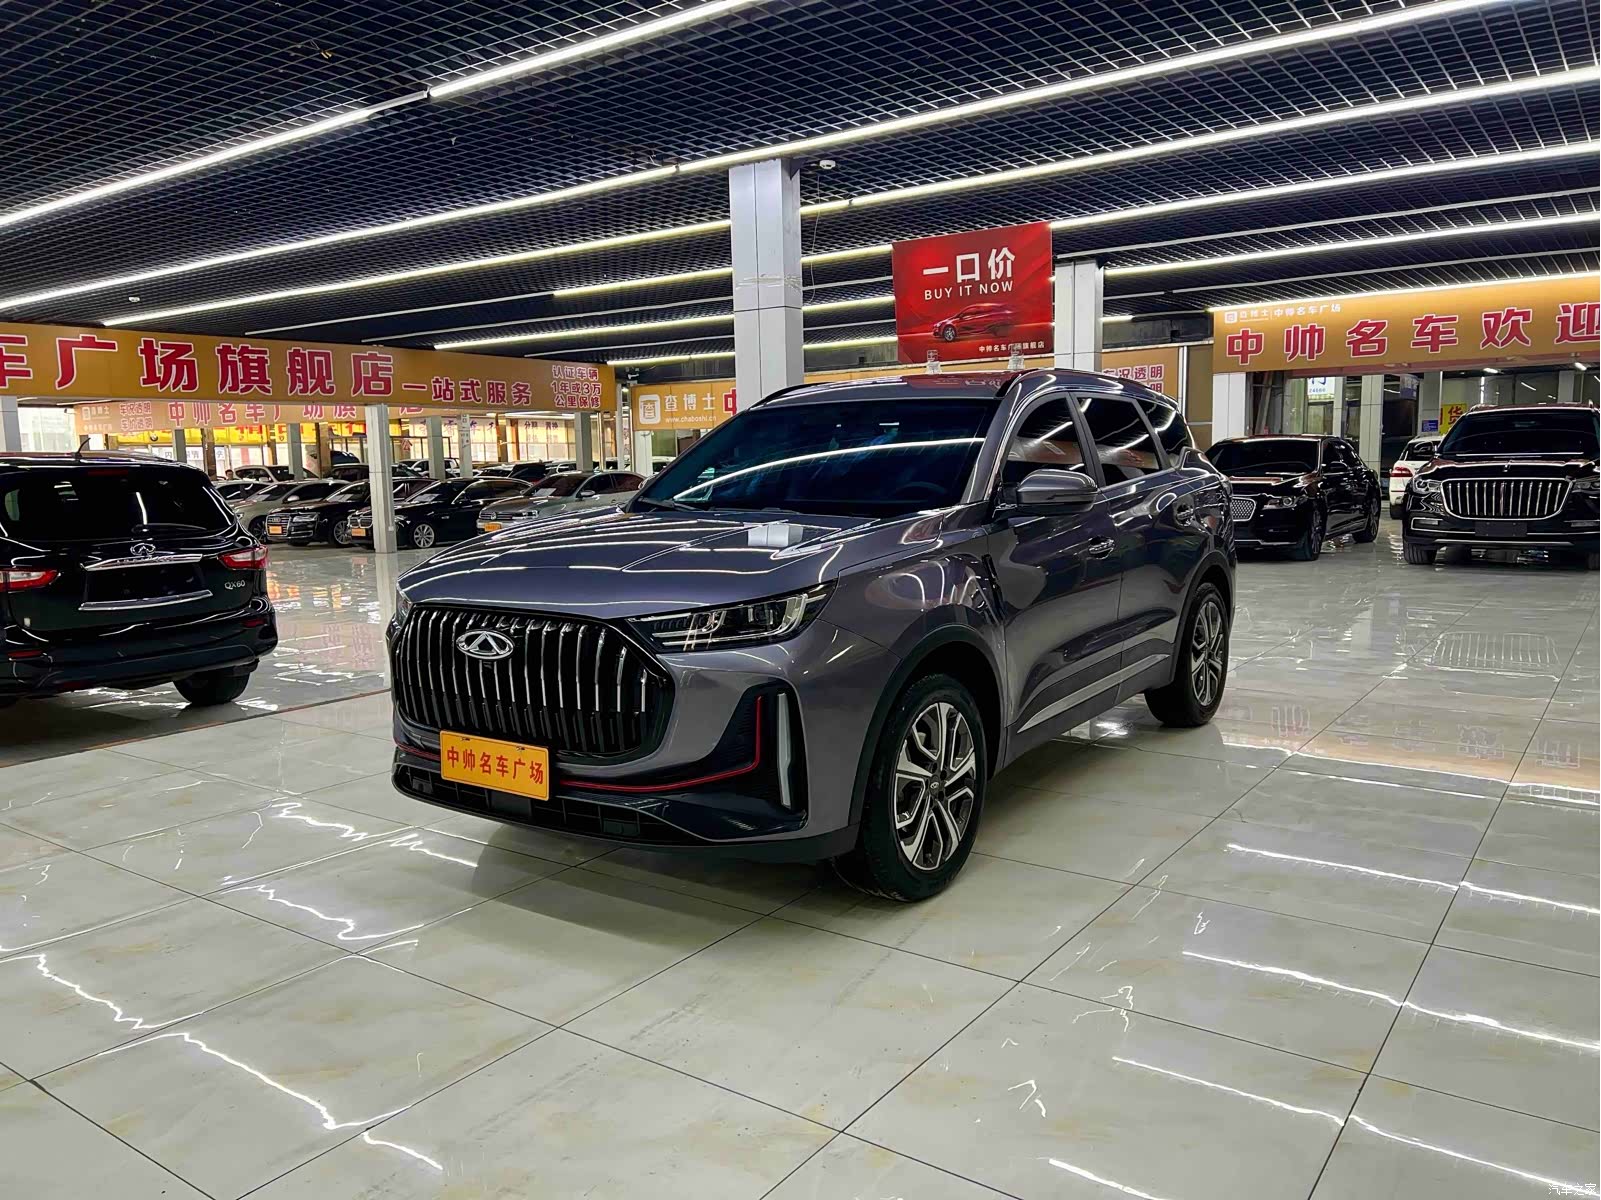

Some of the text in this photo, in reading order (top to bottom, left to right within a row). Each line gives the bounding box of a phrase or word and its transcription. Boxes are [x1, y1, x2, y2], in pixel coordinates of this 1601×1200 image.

[922, 246, 1016, 283] 一口价
[924, 280, 1014, 300] BUY IT NOW
[1226, 302, 1601, 366] 中帅名车欢迎
[552, 365, 599, 381] 认证车辆
[402, 376, 533, 406] 一站式服务
[551, 380, 602, 395] 1年或3万
[554, 394, 601, 408] 公里保修
[664, 393, 717, 412] 查博士
[665, 414, 718, 424] www.chaboshi.cn
[224, 579, 246, 590] QX60
[446, 746, 544, 785] 中帅名车广场
